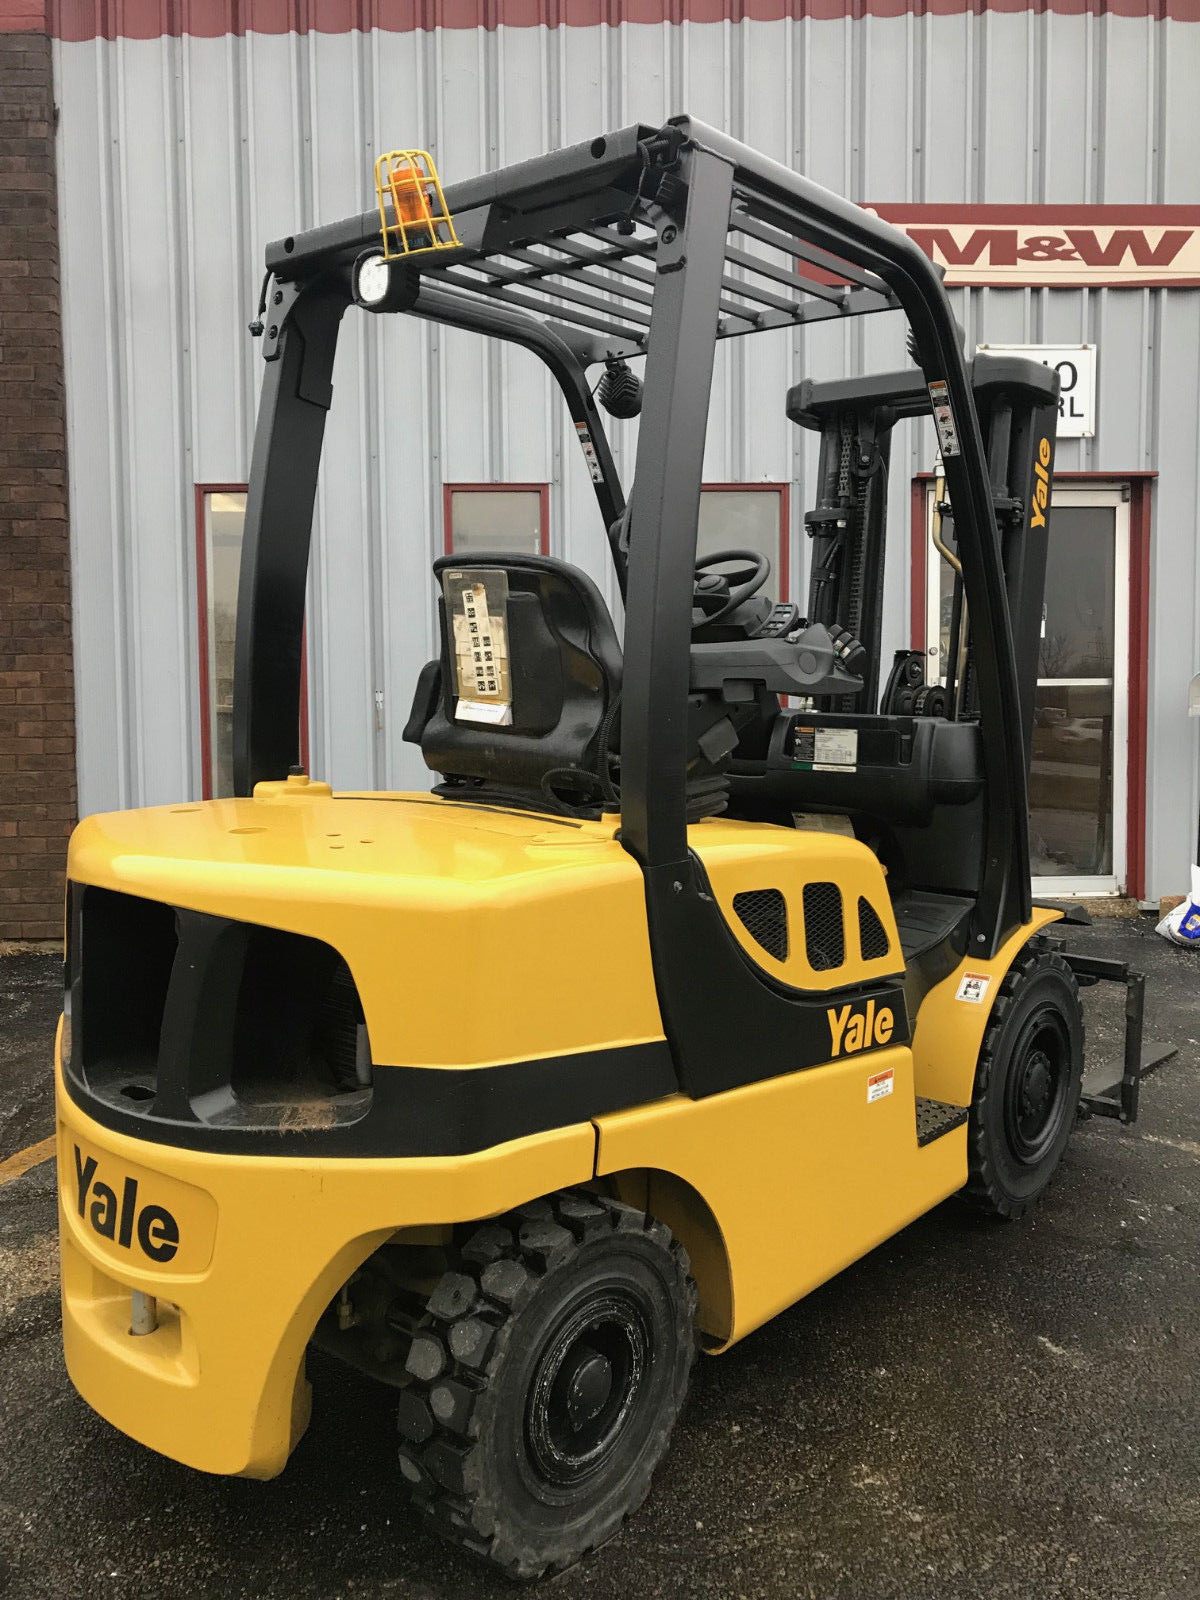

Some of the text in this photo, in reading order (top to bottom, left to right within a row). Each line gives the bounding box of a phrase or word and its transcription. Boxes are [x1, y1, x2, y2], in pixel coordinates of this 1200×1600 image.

[906, 228, 1195, 267] M&W
[1030, 437, 1051, 529] Yale
[827, 999, 894, 1057] Yale
[73, 1143, 180, 1263] Yale
